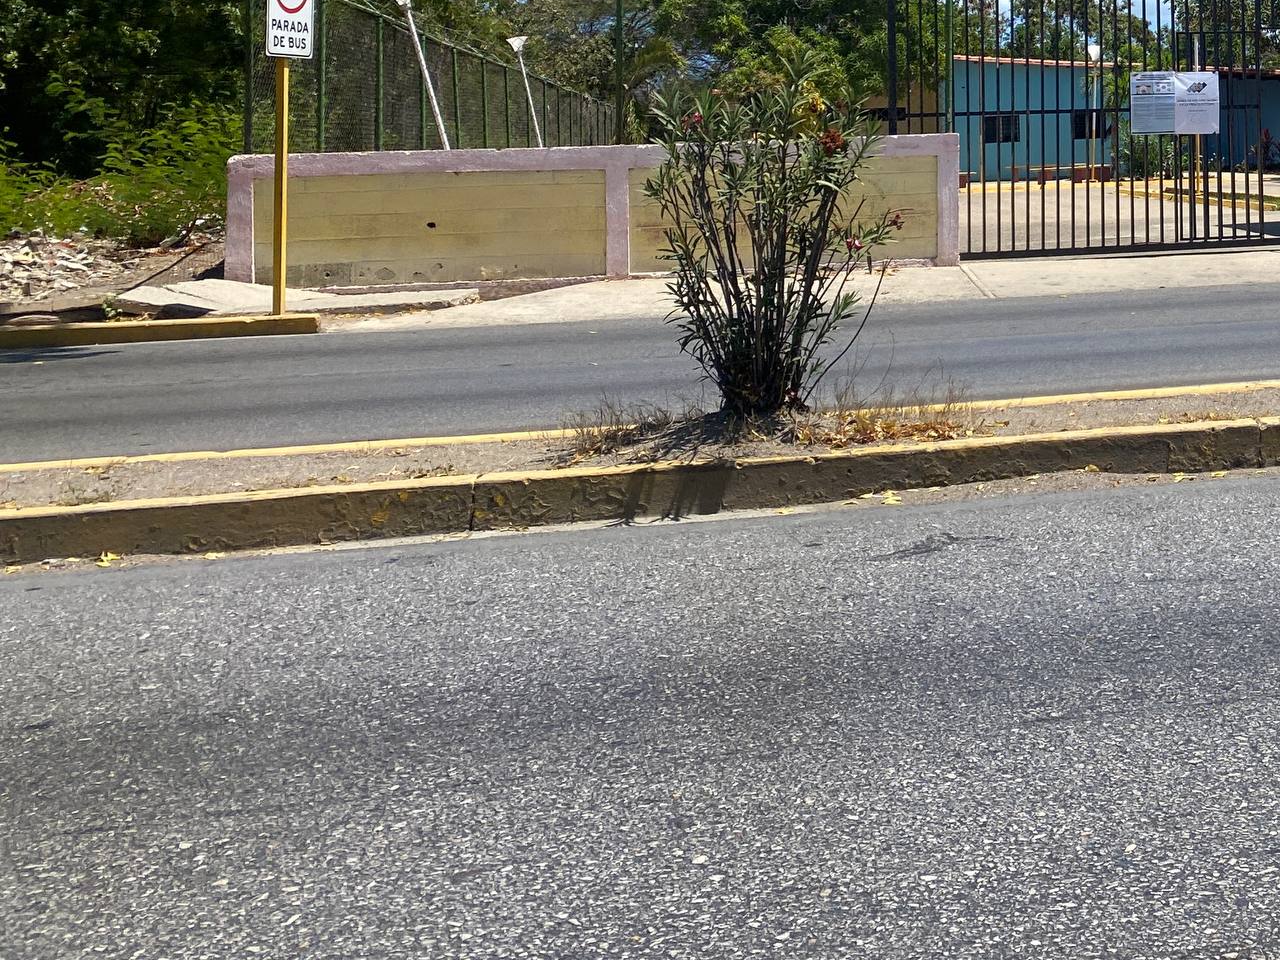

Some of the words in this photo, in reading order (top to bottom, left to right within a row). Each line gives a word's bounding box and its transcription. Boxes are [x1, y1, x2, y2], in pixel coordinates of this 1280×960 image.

[271, 18, 309, 33] PARADA
[273, 35, 285, 47] DE
[288, 36, 306, 49] BUS
